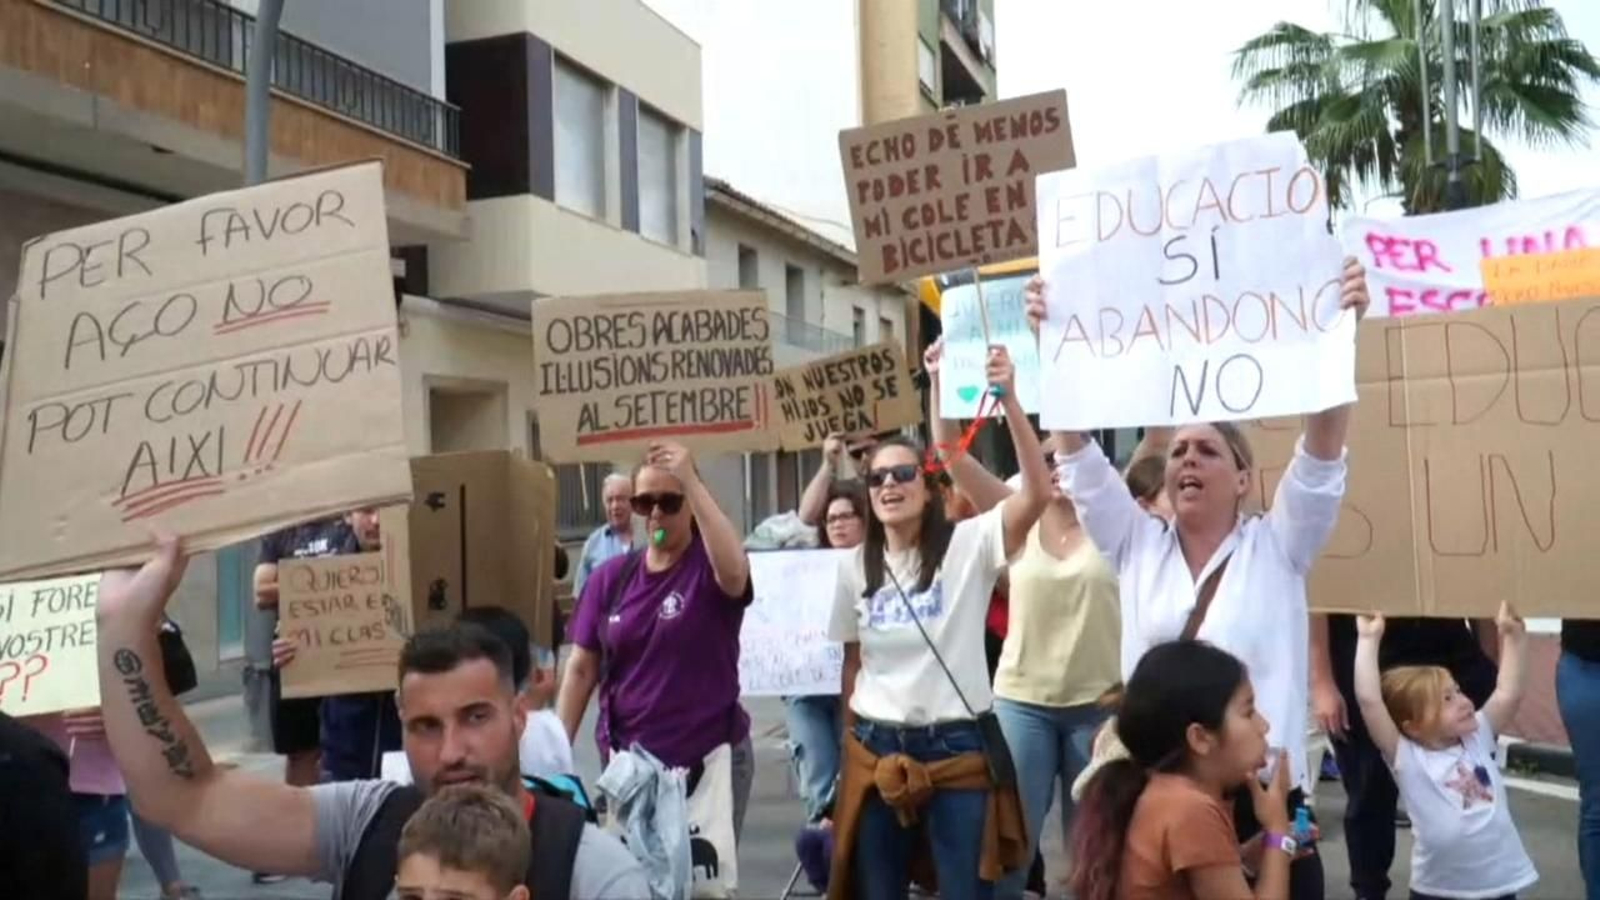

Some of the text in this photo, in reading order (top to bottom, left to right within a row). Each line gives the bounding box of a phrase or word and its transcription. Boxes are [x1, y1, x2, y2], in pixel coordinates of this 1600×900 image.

[852, 133, 915, 169] ECHO
[973, 107, 1061, 144] MENOS
[857, 149, 1030, 205] PODER IR A
[864, 180, 1027, 238] MI COLE EN
[1056, 167, 1318, 249] EDUCACIO
[40, 189, 356, 300] PER FAVOR
[882, 217, 1028, 274] BICICLETA
[1156, 224, 1220, 285] SÍ
[1365, 232, 1453, 273] PER
[64, 275, 314, 370] AÇO NO
[546, 307, 770, 355] OBRES ACABADES
[671, 346, 775, 381] RENOVADES
[801, 348, 896, 393] NUESTROS
[1170, 353, 1263, 417] NO
[27, 338, 395, 455] POT CONTINUAR
[576, 401, 611, 432] AL
[781, 375, 898, 423] HIJOS NO SE
[1424, 449, 1556, 557] UN
[288, 593, 359, 619] ESTAR
